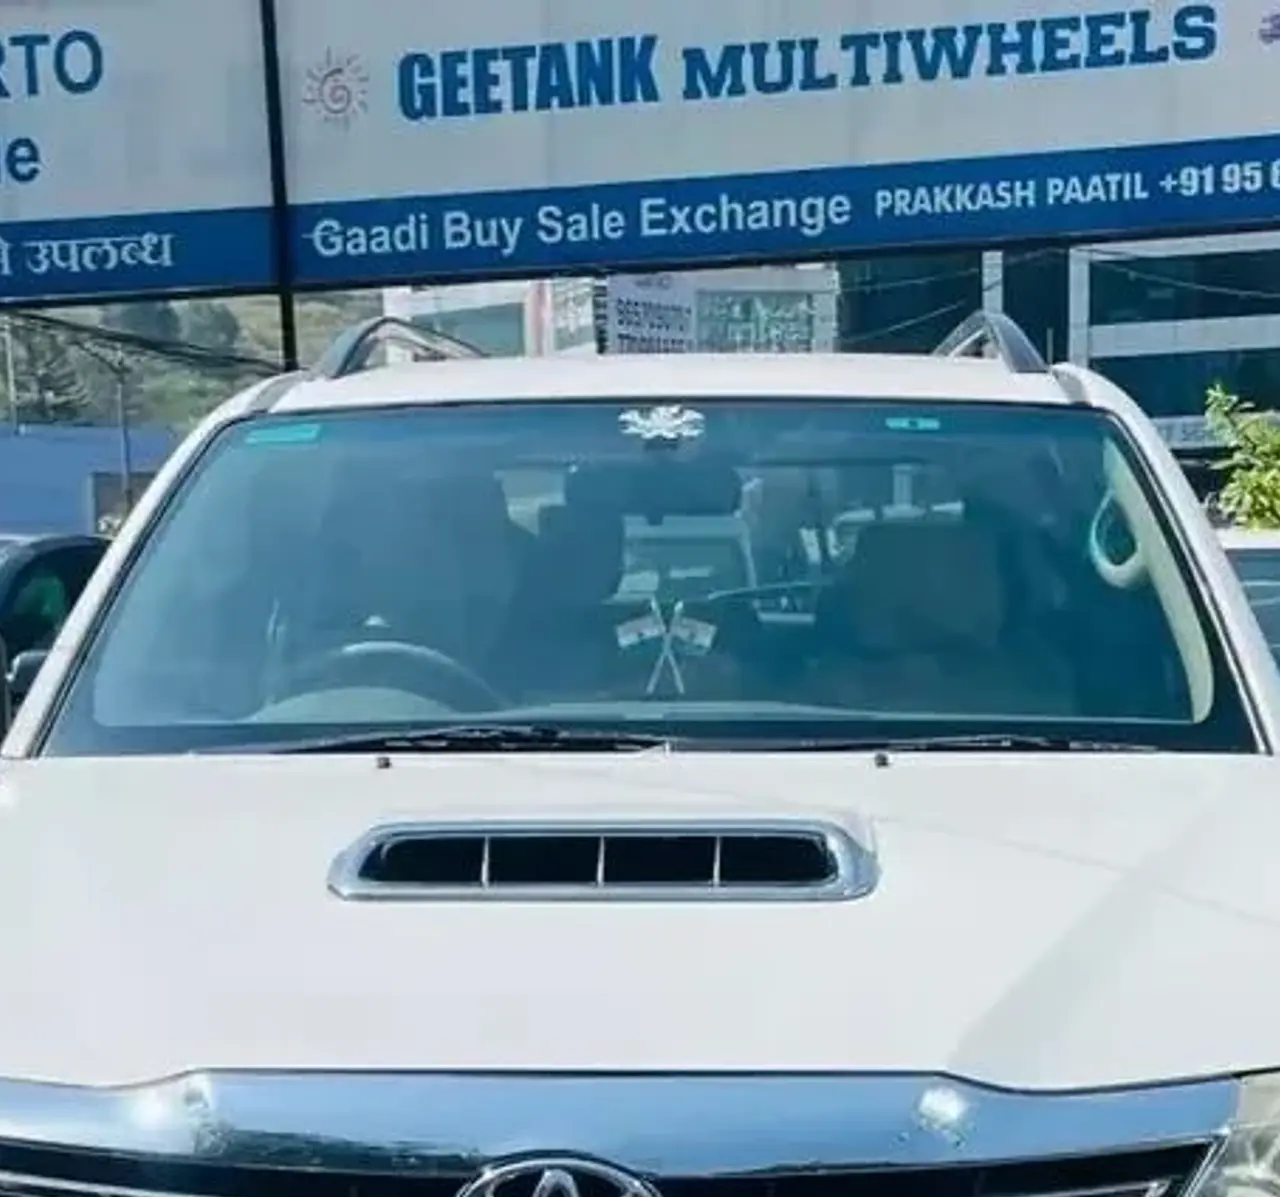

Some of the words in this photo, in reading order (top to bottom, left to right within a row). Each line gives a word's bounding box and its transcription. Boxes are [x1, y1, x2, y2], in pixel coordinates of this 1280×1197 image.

[397, 34, 660, 121] GEETANK
[682, 5, 1218, 99] MULTIWHEELS
[312, 213, 429, 258] Gaadi
[444, 211, 523, 255] Buy
[537, 205, 625, 244] Sale
[640, 195, 852, 236] Exchange
[874, 180, 1037, 219] PRAKKASH
[1046, 172, 1149, 206] PAATIL
[1159, 165, 1215, 197] +91
[1221, 161, 1263, 194] 95
